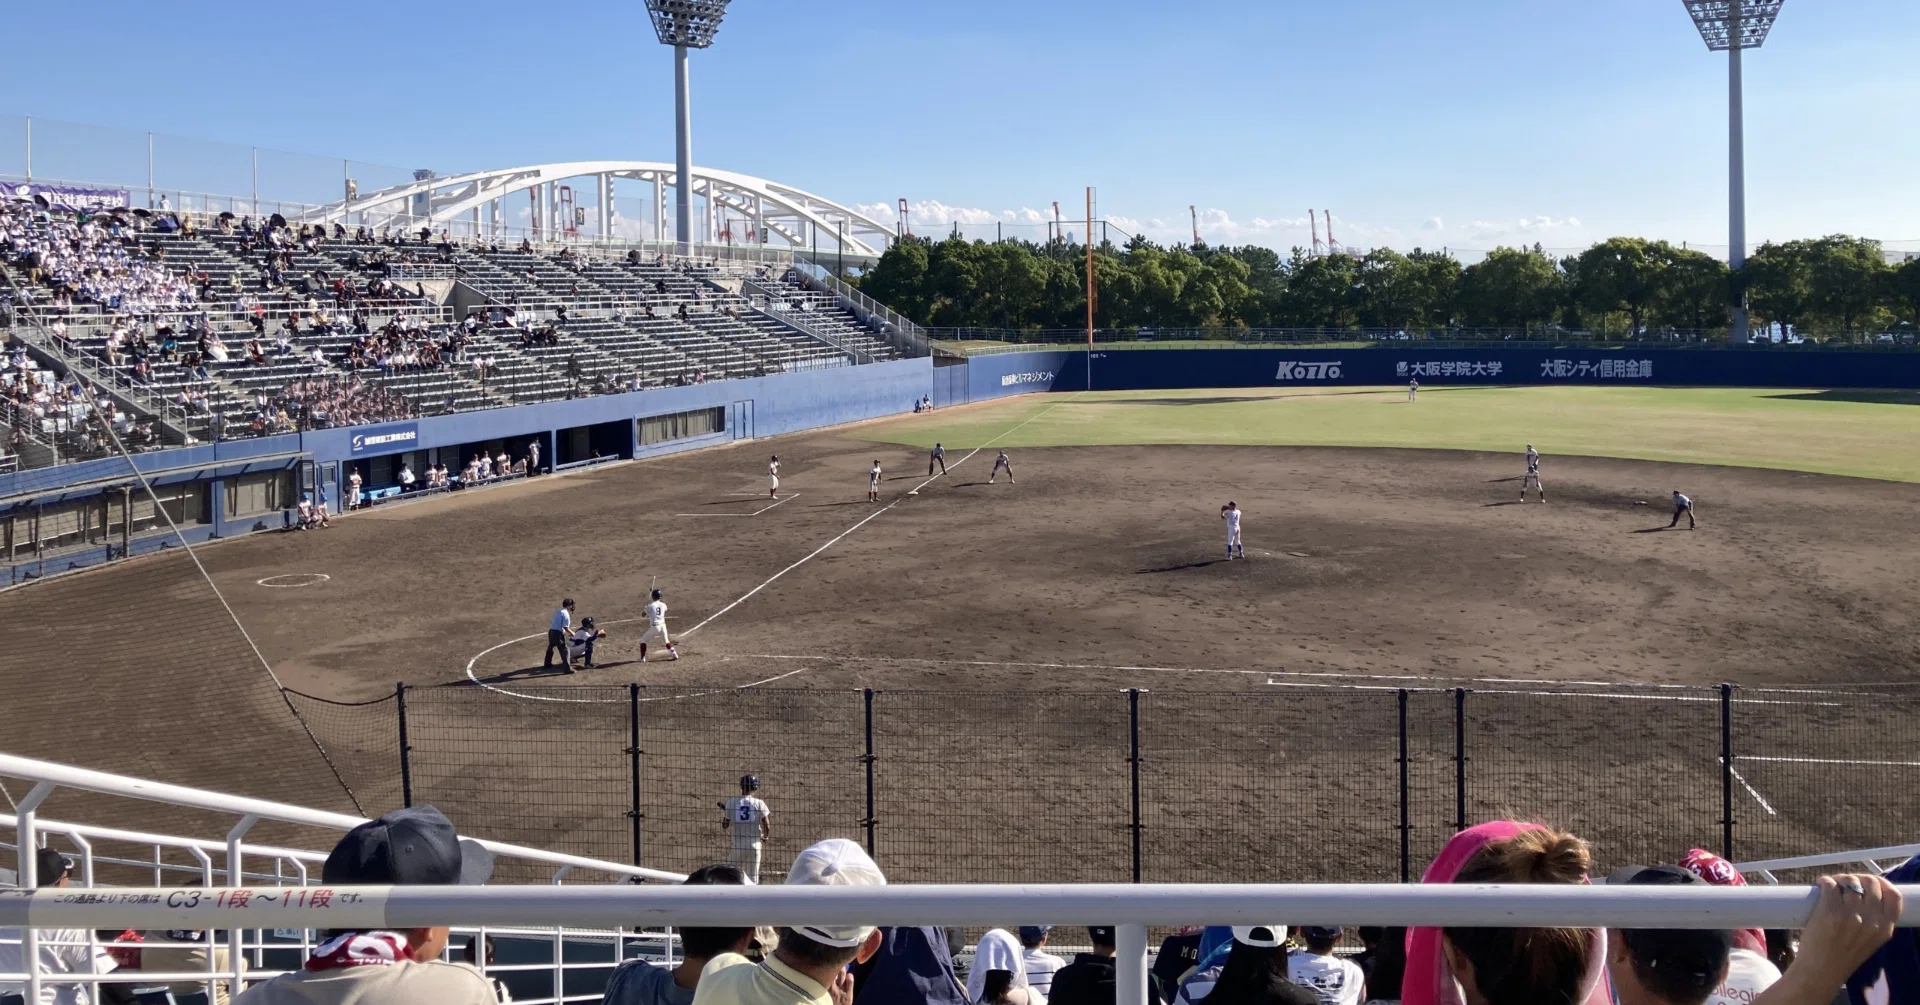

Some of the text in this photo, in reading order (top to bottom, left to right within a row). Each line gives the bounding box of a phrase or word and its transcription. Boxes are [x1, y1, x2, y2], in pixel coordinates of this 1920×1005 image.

[1410, 361, 1503, 376] 大阪学院大学
[1540, 359, 1653, 378] 大阪シティ信用金庫
[740, 805, 750, 821] 3
